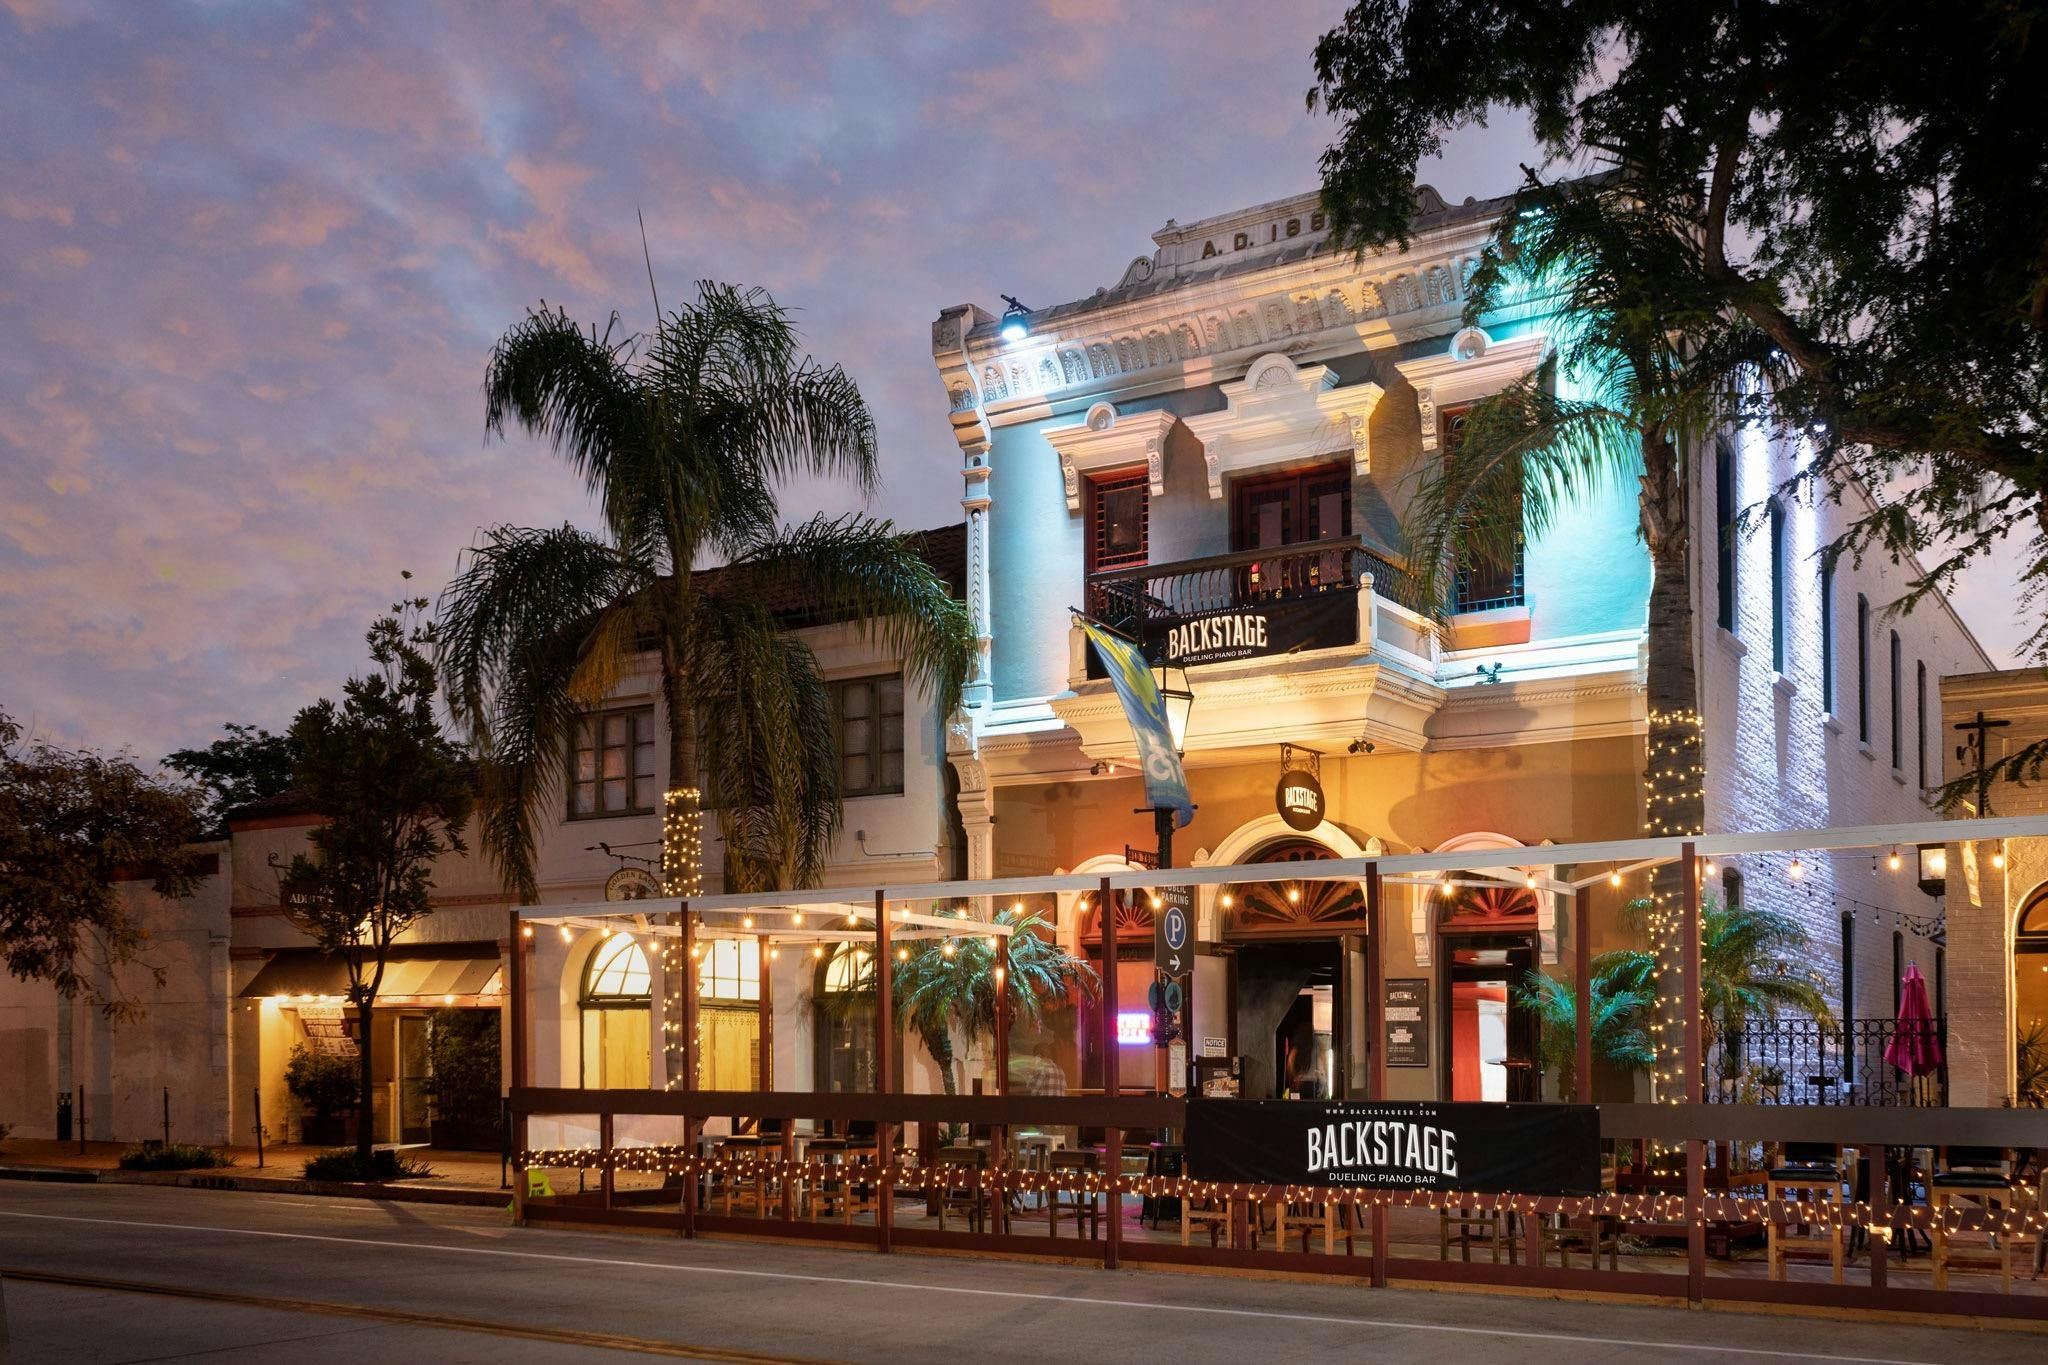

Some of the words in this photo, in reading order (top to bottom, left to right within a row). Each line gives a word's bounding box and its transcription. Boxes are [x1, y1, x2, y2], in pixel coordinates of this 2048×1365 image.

[1168, 615, 1268, 659] BACKSTAGE
[1182, 652, 1214, 663] DUELING
[1214, 650, 1237, 661] PIANO
[1237, 648, 1252, 657] BAR
[1285, 787, 1318, 812] BACKSTAGE
[1161, 892, 1189, 905] PARKING
[1170, 914, 1182, 942] P
[1389, 991, 1413, 1000] BACKSTAGE
[1205, 1039, 1225, 1047] NOTICE
[1325, 1108, 1437, 1116] WWW.BACKSTAGESB.COM
[1307, 1120, 1459, 1179] BACKSTAGE
[1329, 1172, 1376, 1182] DUELING
[1378, 1173, 1412, 1184] PIANO
[1414, 1175, 1436, 1184] BAR
